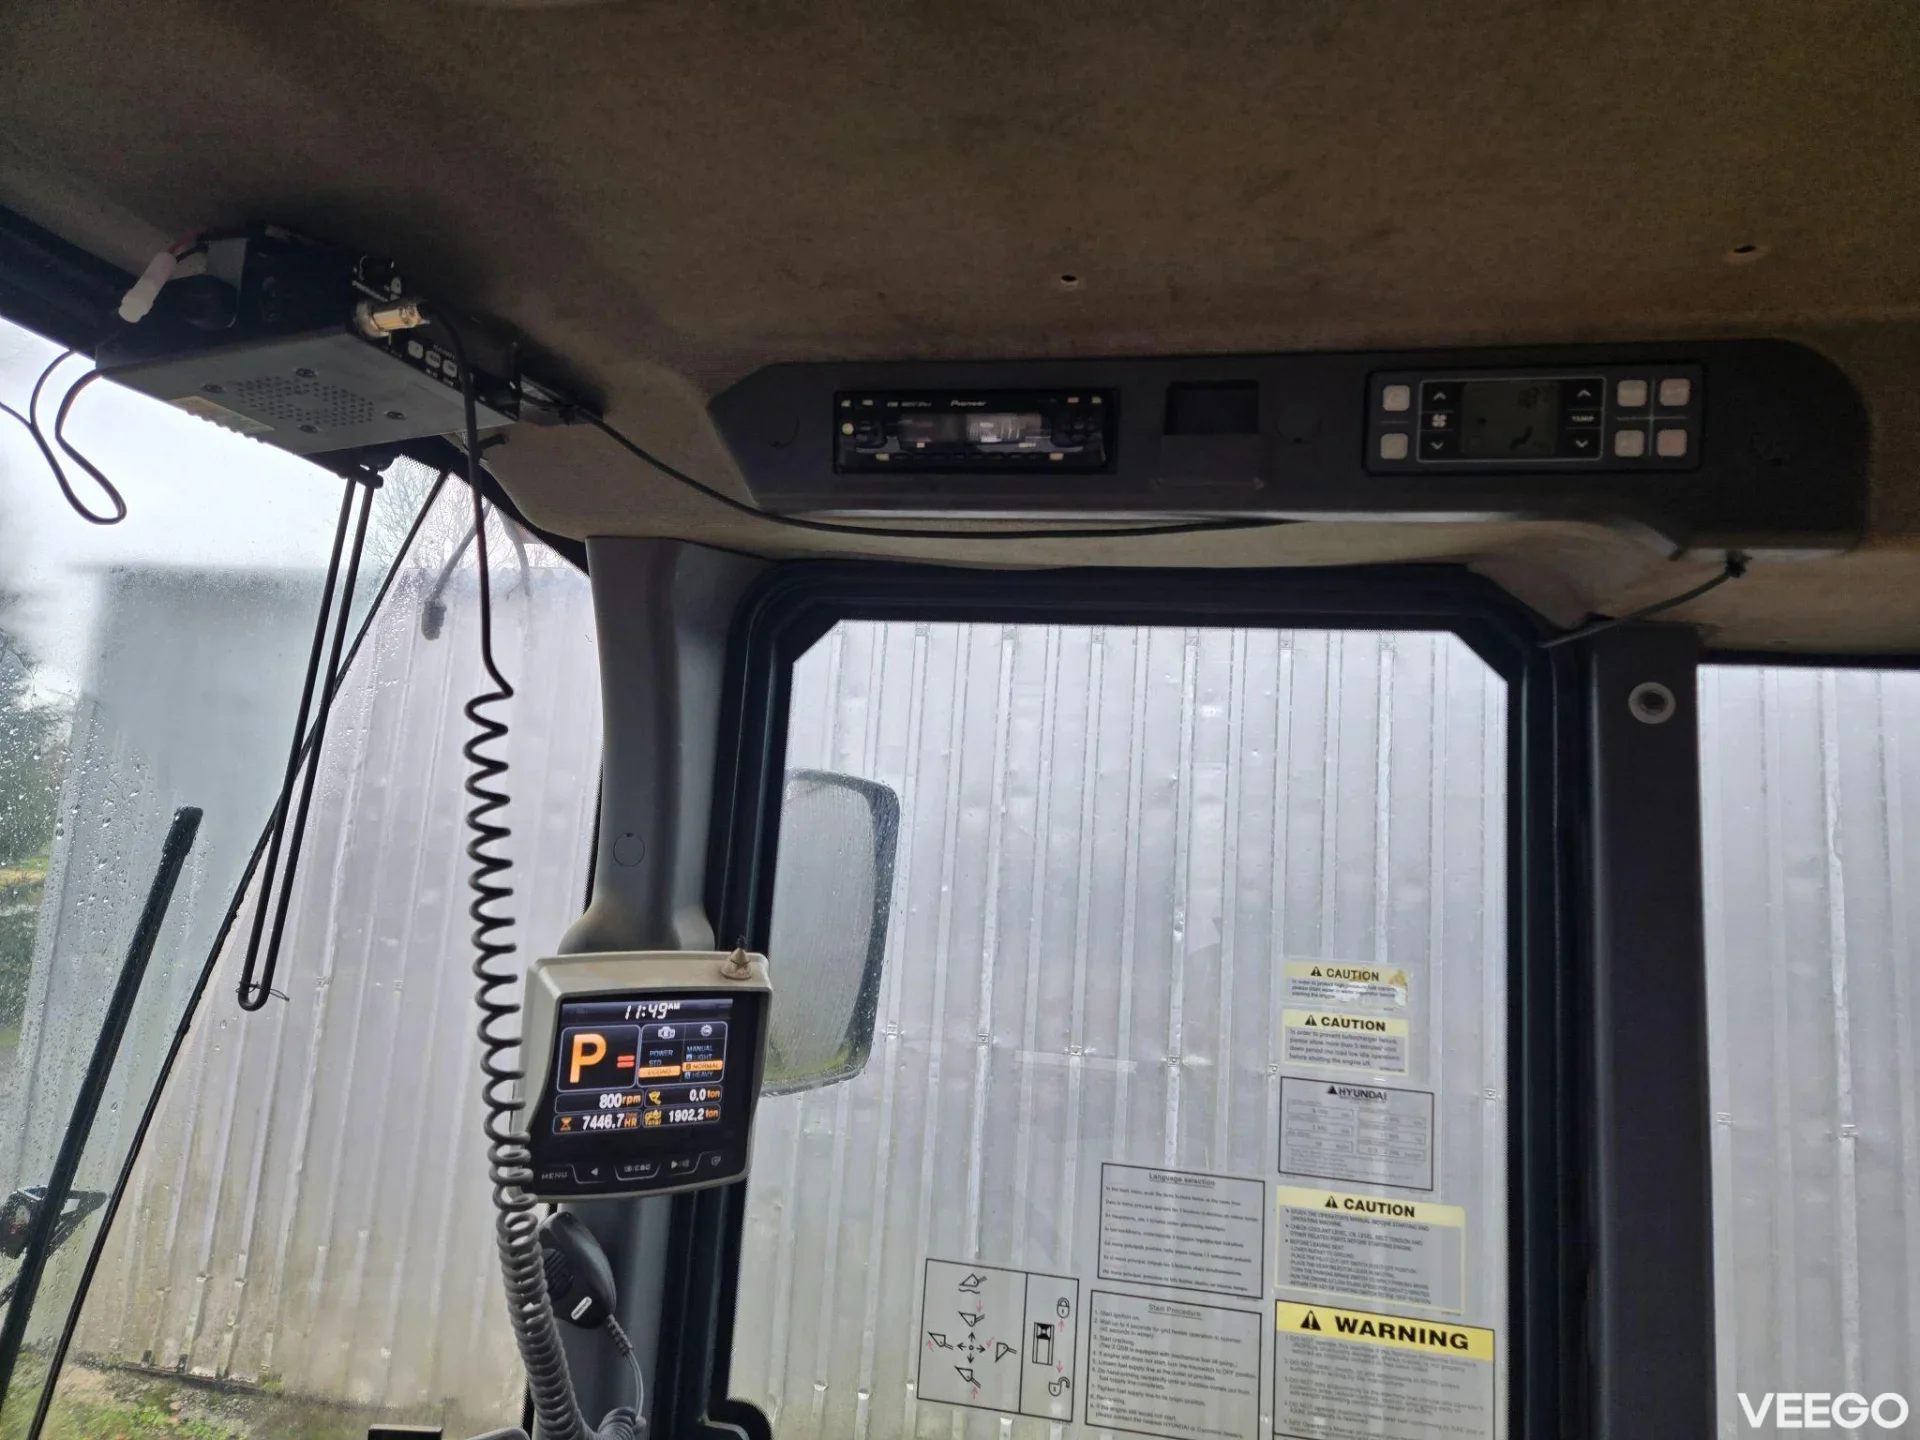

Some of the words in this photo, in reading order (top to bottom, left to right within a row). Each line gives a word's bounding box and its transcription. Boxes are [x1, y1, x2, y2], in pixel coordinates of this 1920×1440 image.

[1326, 967, 1379, 981] CAUTION
[624, 1004, 668, 1020] 11:49
[1321, 1016, 1386, 1032] CAUTION
[569, 1033, 607, 1083] P
[649, 1050, 674, 1058] POWER
[600, 1093, 622, 1109] 800
[622, 1094, 641, 1105] rpm
[689, 1089, 707, 1101] 0.0
[707, 1089, 721, 1100] ton
[1338, 1086, 1388, 1101] HYUNDAI
[582, 1113, 625, 1130] 7446.7
[624, 1118, 638, 1128] HR
[669, 1108, 705, 1122] 1902.2
[705, 1109, 719, 1119] ton
[541, 1172, 568, 1181] MENU
[1148, 1172, 1182, 1184] Language
[1343, 1198, 1416, 1218] CAUTION
[1149, 1304, 1165, 1312] Start
[1334, 1315, 1469, 1351] WARNING
